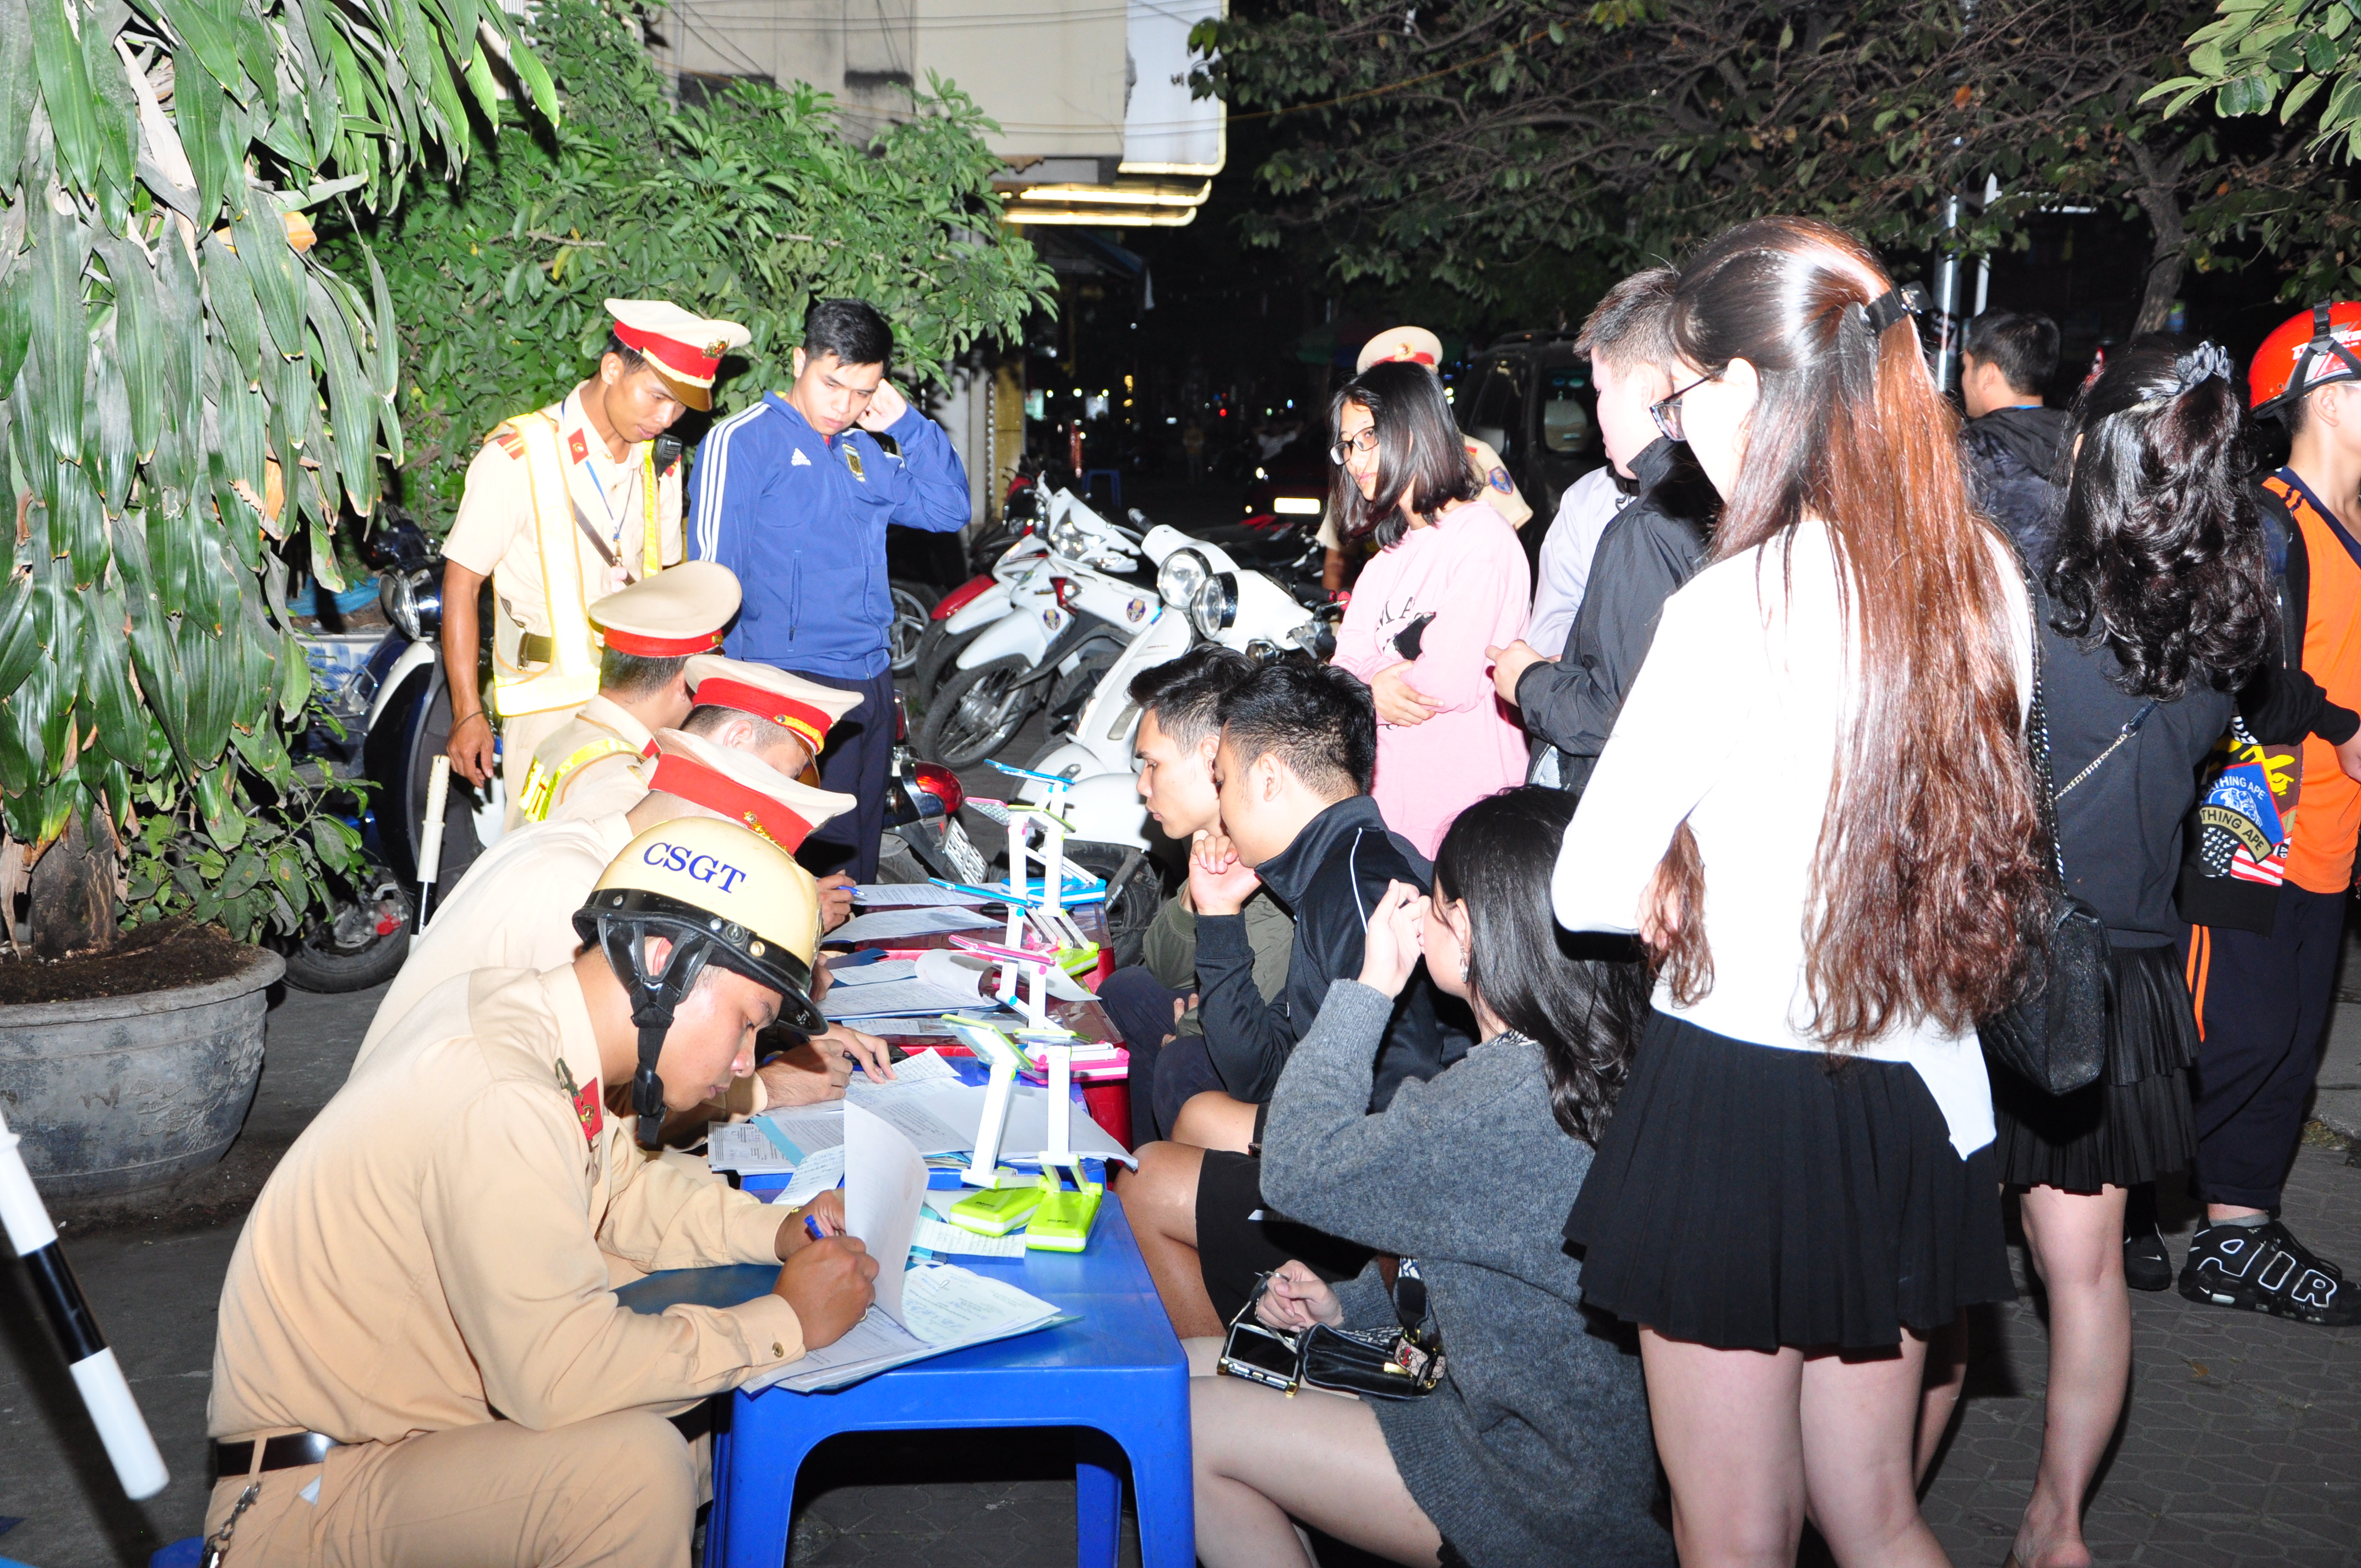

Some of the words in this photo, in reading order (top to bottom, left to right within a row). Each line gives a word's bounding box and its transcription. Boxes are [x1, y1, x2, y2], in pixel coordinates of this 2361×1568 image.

[2248, 782, 2266, 800] APE
[2242, 829, 2264, 851] APE
[643, 842, 746, 893] CSGT
[2197, 1239, 2338, 1308] AIR
